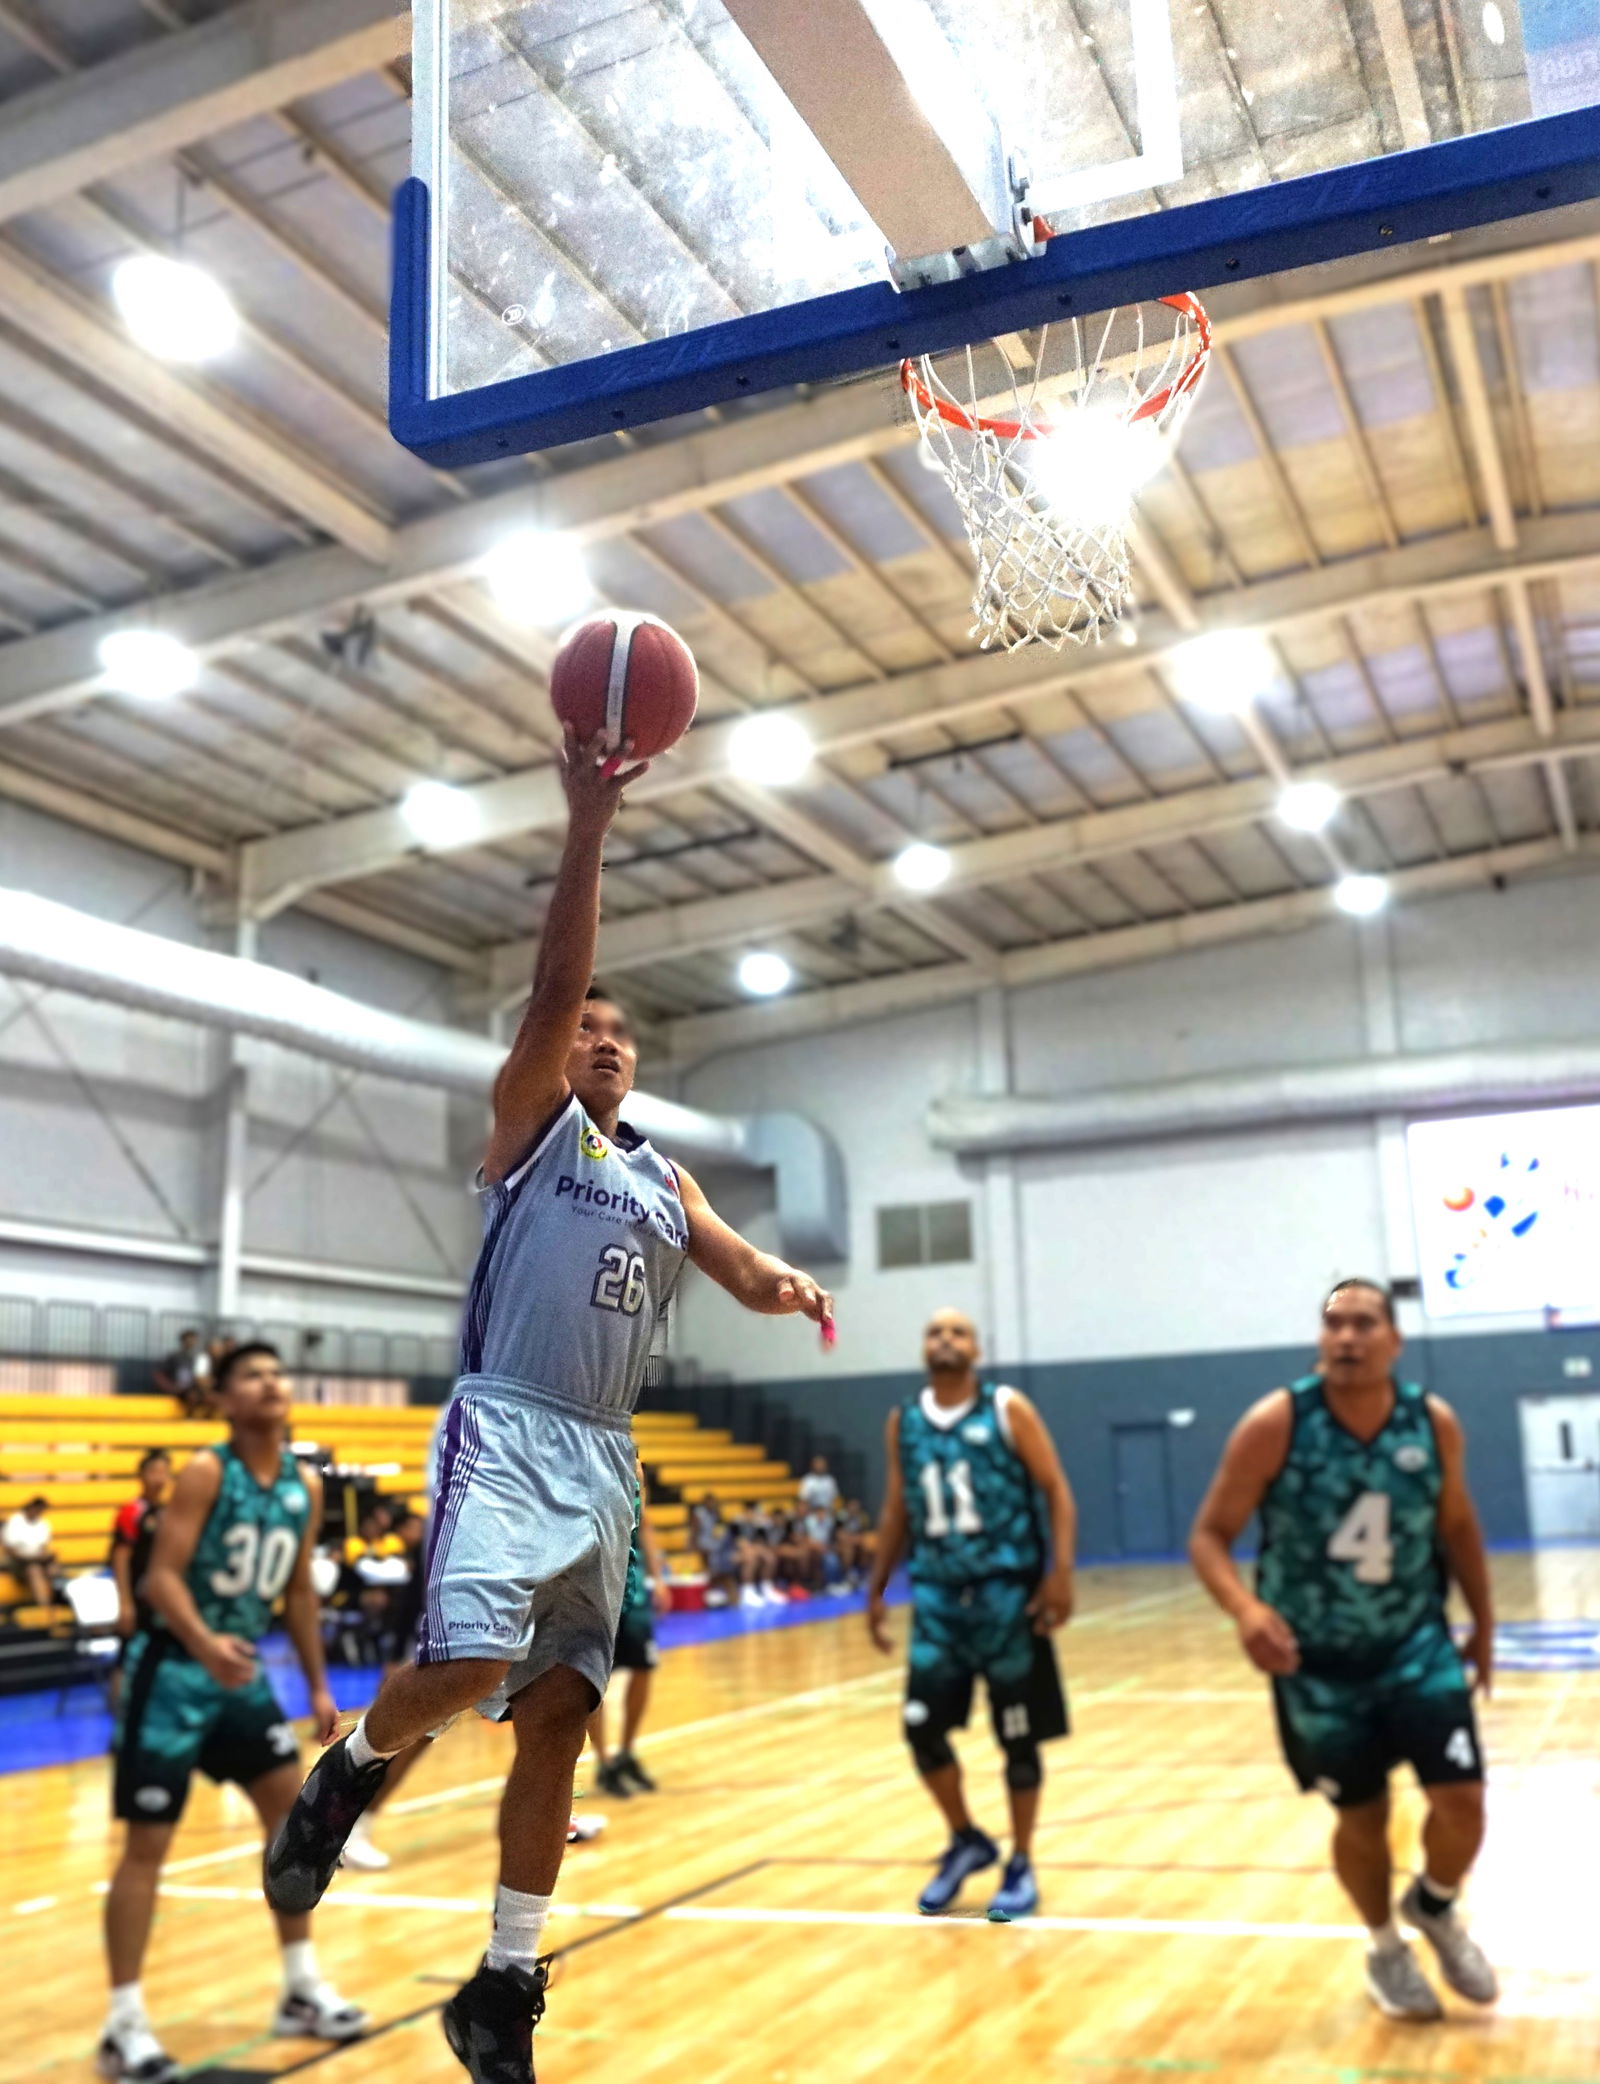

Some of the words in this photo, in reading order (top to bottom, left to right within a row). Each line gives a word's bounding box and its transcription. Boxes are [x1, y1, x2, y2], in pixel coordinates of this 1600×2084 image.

[556, 1175, 650, 1223] Priority
[656, 1211, 689, 1250] Care
[572, 1205, 595, 1217] Your
[598, 1212, 622, 1224] Care
[590, 1243, 646, 1317] 26
[919, 1459, 982, 1537] 11
[211, 1522, 298, 1600] 30
[1327, 1492, 1394, 1584] 4
[448, 1620, 490, 1632] Priority
[1445, 1728, 1475, 1769] 4
